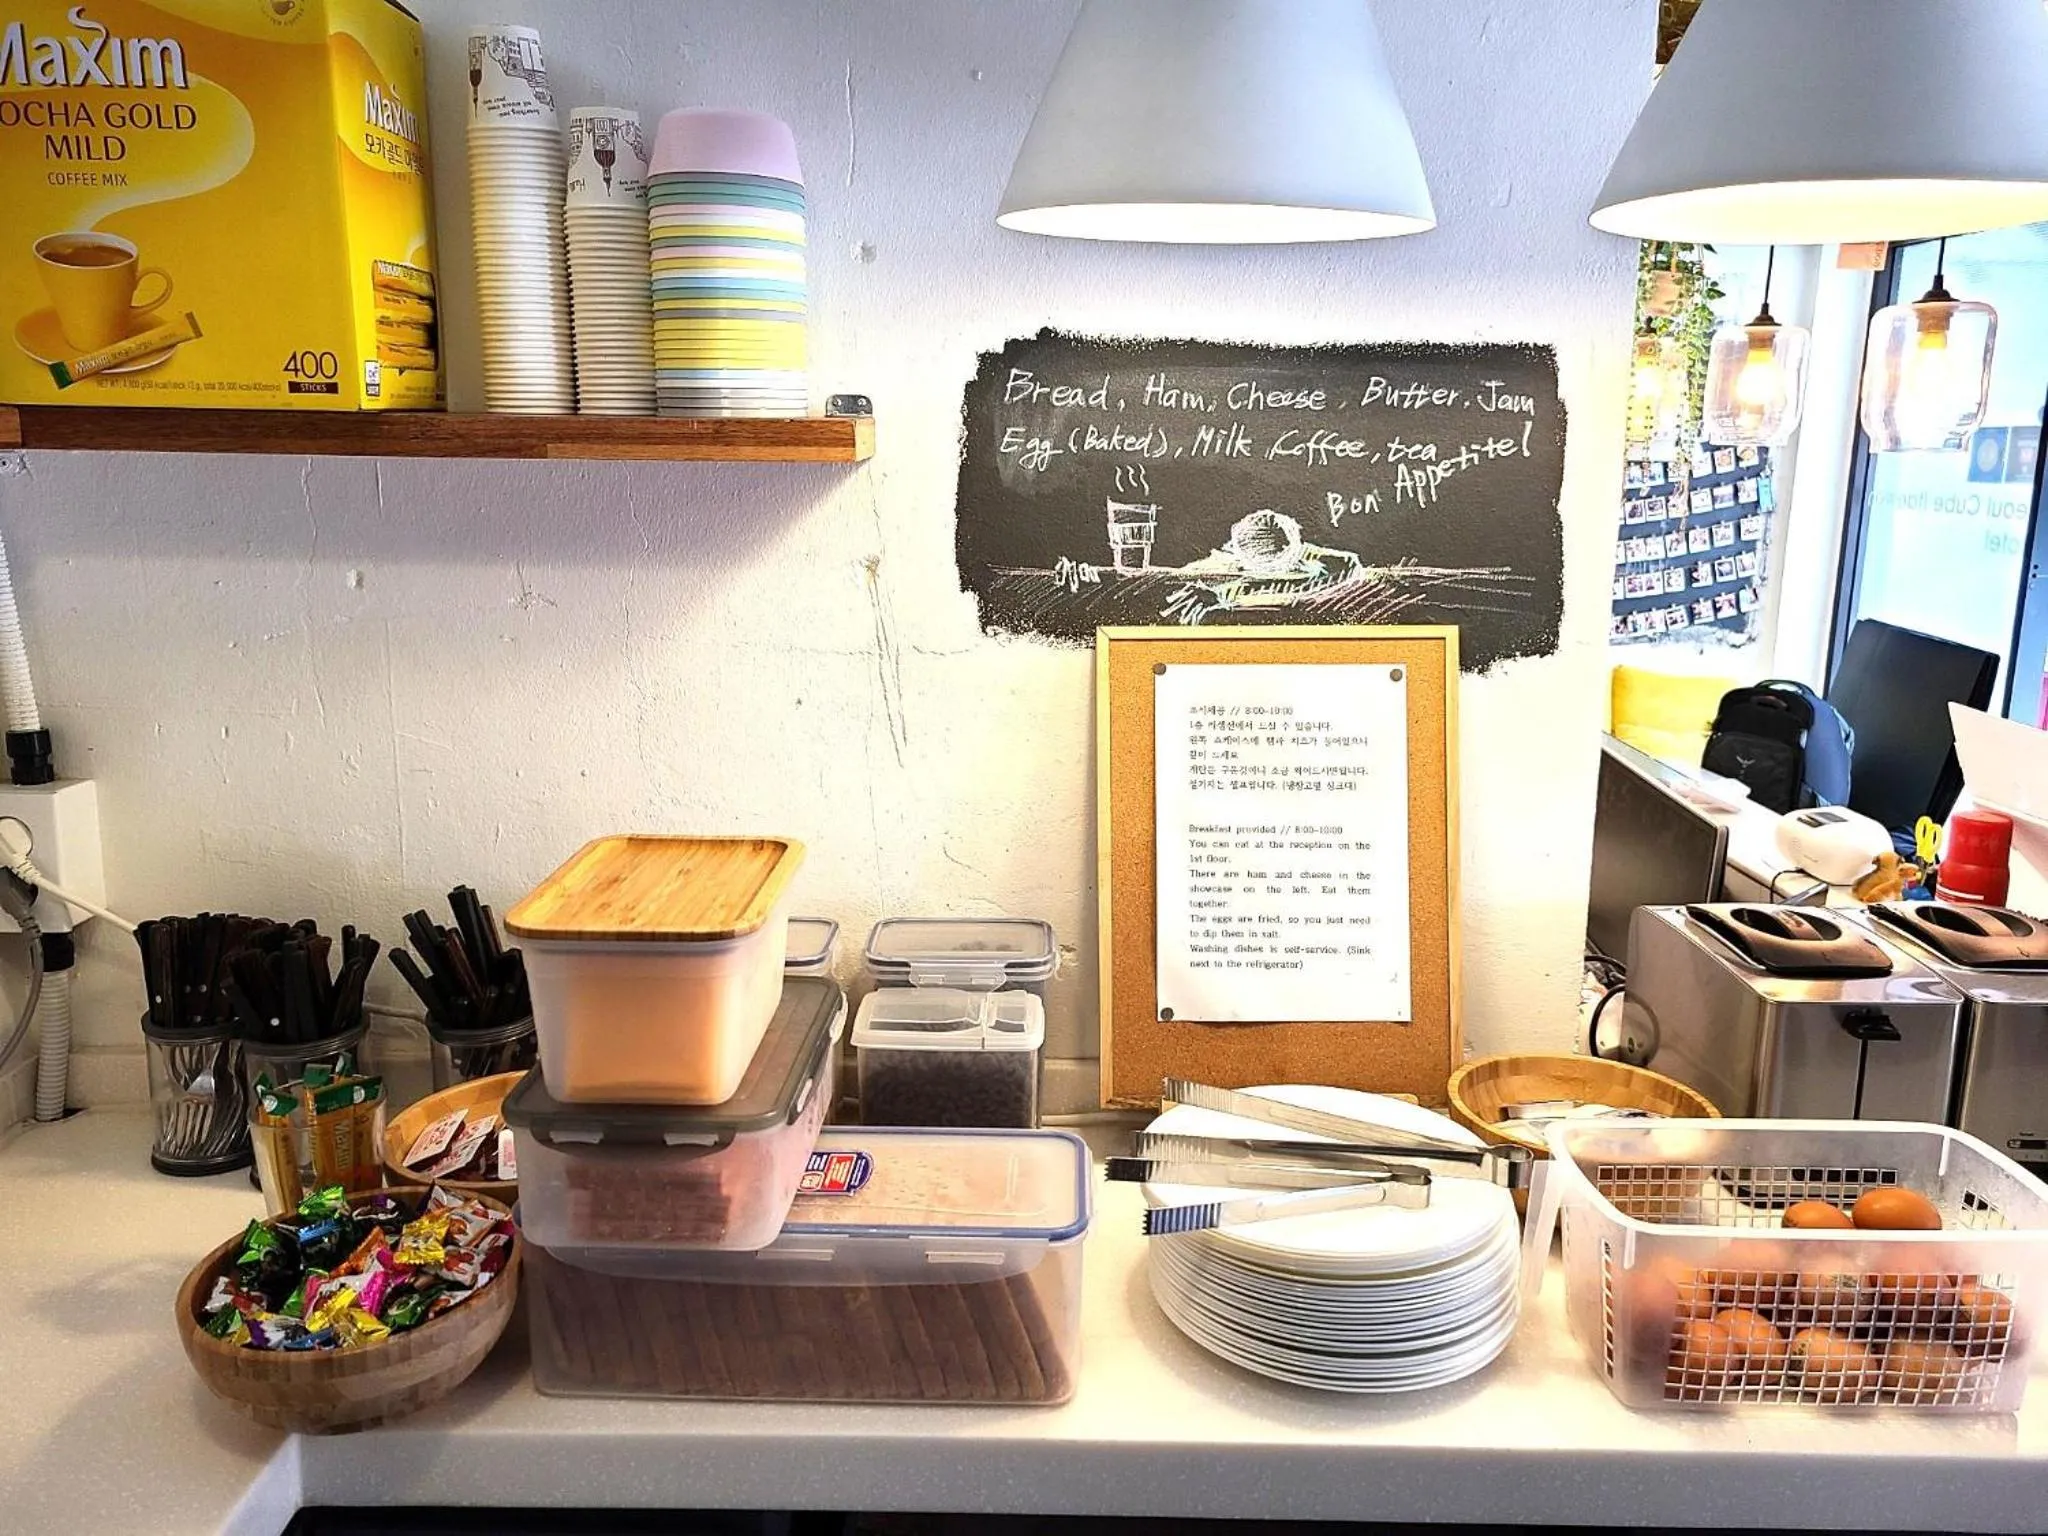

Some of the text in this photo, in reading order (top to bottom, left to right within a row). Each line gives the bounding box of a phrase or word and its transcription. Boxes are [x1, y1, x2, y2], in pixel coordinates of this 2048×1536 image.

[0, 10, 189, 89] Maxim
[0, 100, 197, 130] OCHA GOLD
[45, 134, 127, 161] MILD
[48, 172, 128, 187] COFFEE MIX
[283, 350, 338, 379] 400
[300, 383, 327, 392] STICKS
[1004, 368, 1125, 412] Bread,
[1477, 380, 1535, 416] Jam
[1000, 426, 1063, 471] Egg
[1068, 423, 1183, 459] (Baked),
[1388, 436, 1437, 462] tea
[1327, 489, 1381, 527] Bon
[1281, 721, 1290, 732] 수
[1188, 824, 1232, 833] Breakfast
[1235, 824, 1277, 837] provided
[1188, 839, 1208, 849] You
[1234, 840, 1250, 848] eat
[1253, 840, 1264, 849] at
[1268, 841, 1285, 849] the
[1289, 840, 1333, 851] reception
[1337, 842, 1351, 851] on
[1354, 841, 1372, 851] the
[1189, 854, 1232, 864] 1st floor.
[1187, 869, 1217, 879] There
[1246, 869, 1268, 879] ham
[1274, 871, 1293, 879] and
[1299, 871, 1333, 879] cheese
[1355, 871, 1372, 881] the
[1189, 884, 1233, 894] showcase
[1266, 885, 1283, 894] the
[1291, 885, 1311, 894] left.
[1320, 885, 1337, 894] Eat
[1346, 886, 1371, 896] them
[1189, 914, 1208, 924] The
[1211, 915, 1233, 925] eggs
[1237, 915, 1254, 923] are
[1257, 912, 1283, 925] fried,
[1303, 916, 1322, 925] you
[1326, 915, 1344, 926] just
[1348, 916, 1372, 925] need
[1189, 930, 1200, 938] to
[1201, 929, 1218, 940] dip
[1221, 929, 1245, 938] them
[1248, 928, 1259, 938] in
[1189, 944, 1229, 954] Washing
[1233, 943, 1265, 954] dishes
[1269, 945, 1279, 954] is
[1346, 945, 1372, 956] (Sink
[1189, 958, 1304, 971] next to the refrigerator)
